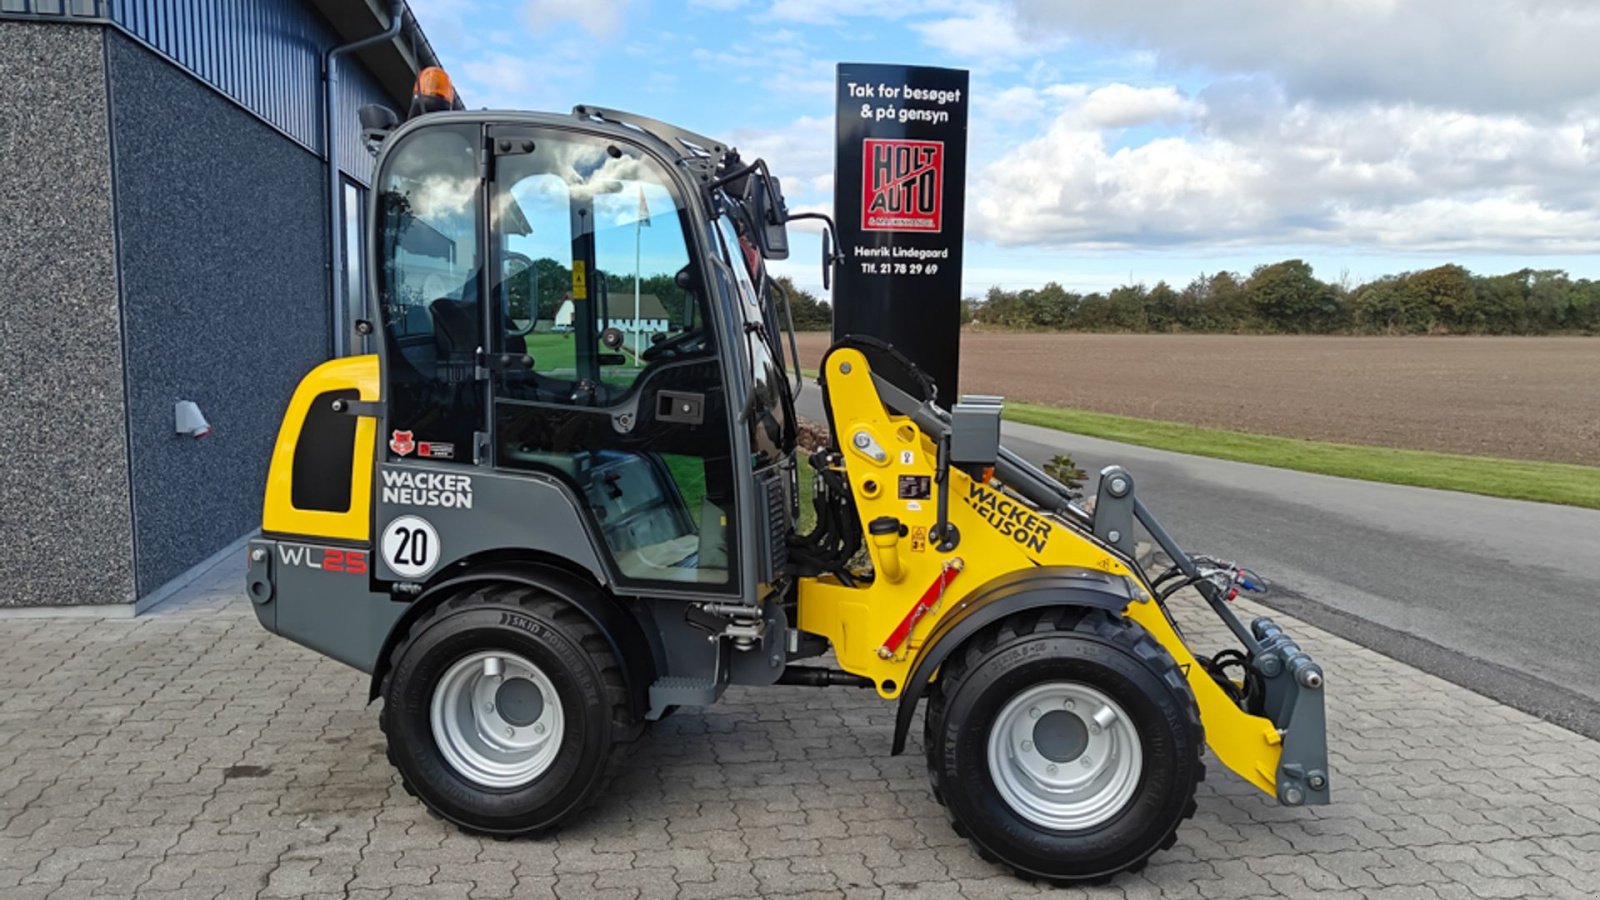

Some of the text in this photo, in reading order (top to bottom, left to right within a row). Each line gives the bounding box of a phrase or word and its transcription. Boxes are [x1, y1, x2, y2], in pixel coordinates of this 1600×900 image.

[847, 82, 961, 104] Tak for besøget
[860, 103, 949, 125] & på gensyn
[873, 144, 936, 192] HOLT
[868, 166, 936, 215] AUTO
[854, 246, 948, 260] Henrik Lindegaard
[880, 263, 891, 274] 21
[894, 263, 907, 275] 78
[909, 263, 922, 275] 29
[924, 264, 938, 275] 69
[382, 470, 472, 492] WACKER
[382, 487, 472, 509] NEUSON
[970, 481, 1052, 540] WACKER
[394, 526, 428, 566] 20
[278, 544, 367, 575] WL25
[511, 616, 540, 634] SKID
